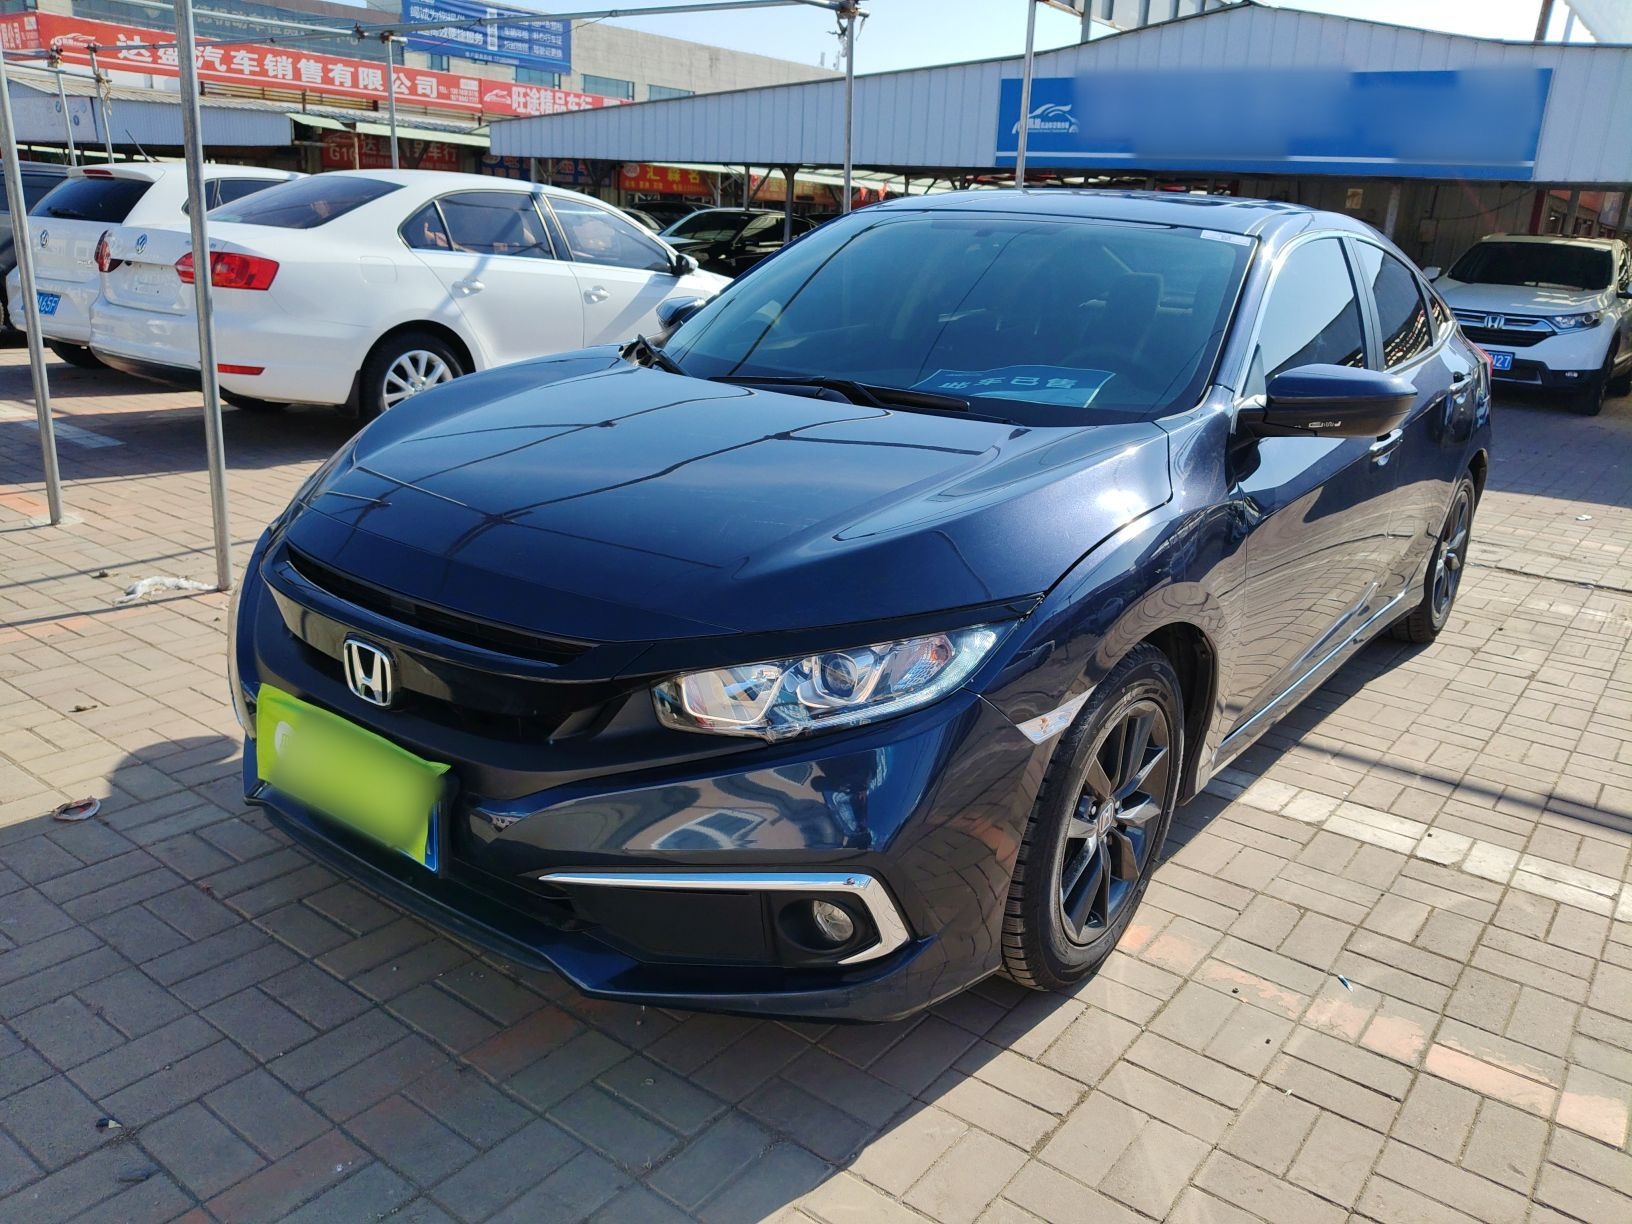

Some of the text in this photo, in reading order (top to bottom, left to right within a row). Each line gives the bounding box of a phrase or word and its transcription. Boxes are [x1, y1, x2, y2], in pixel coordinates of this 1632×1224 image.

[116, 33, 438, 98] 达盛汽车销售有限公司
[511, 86, 593, 115] 旺途精品车行
